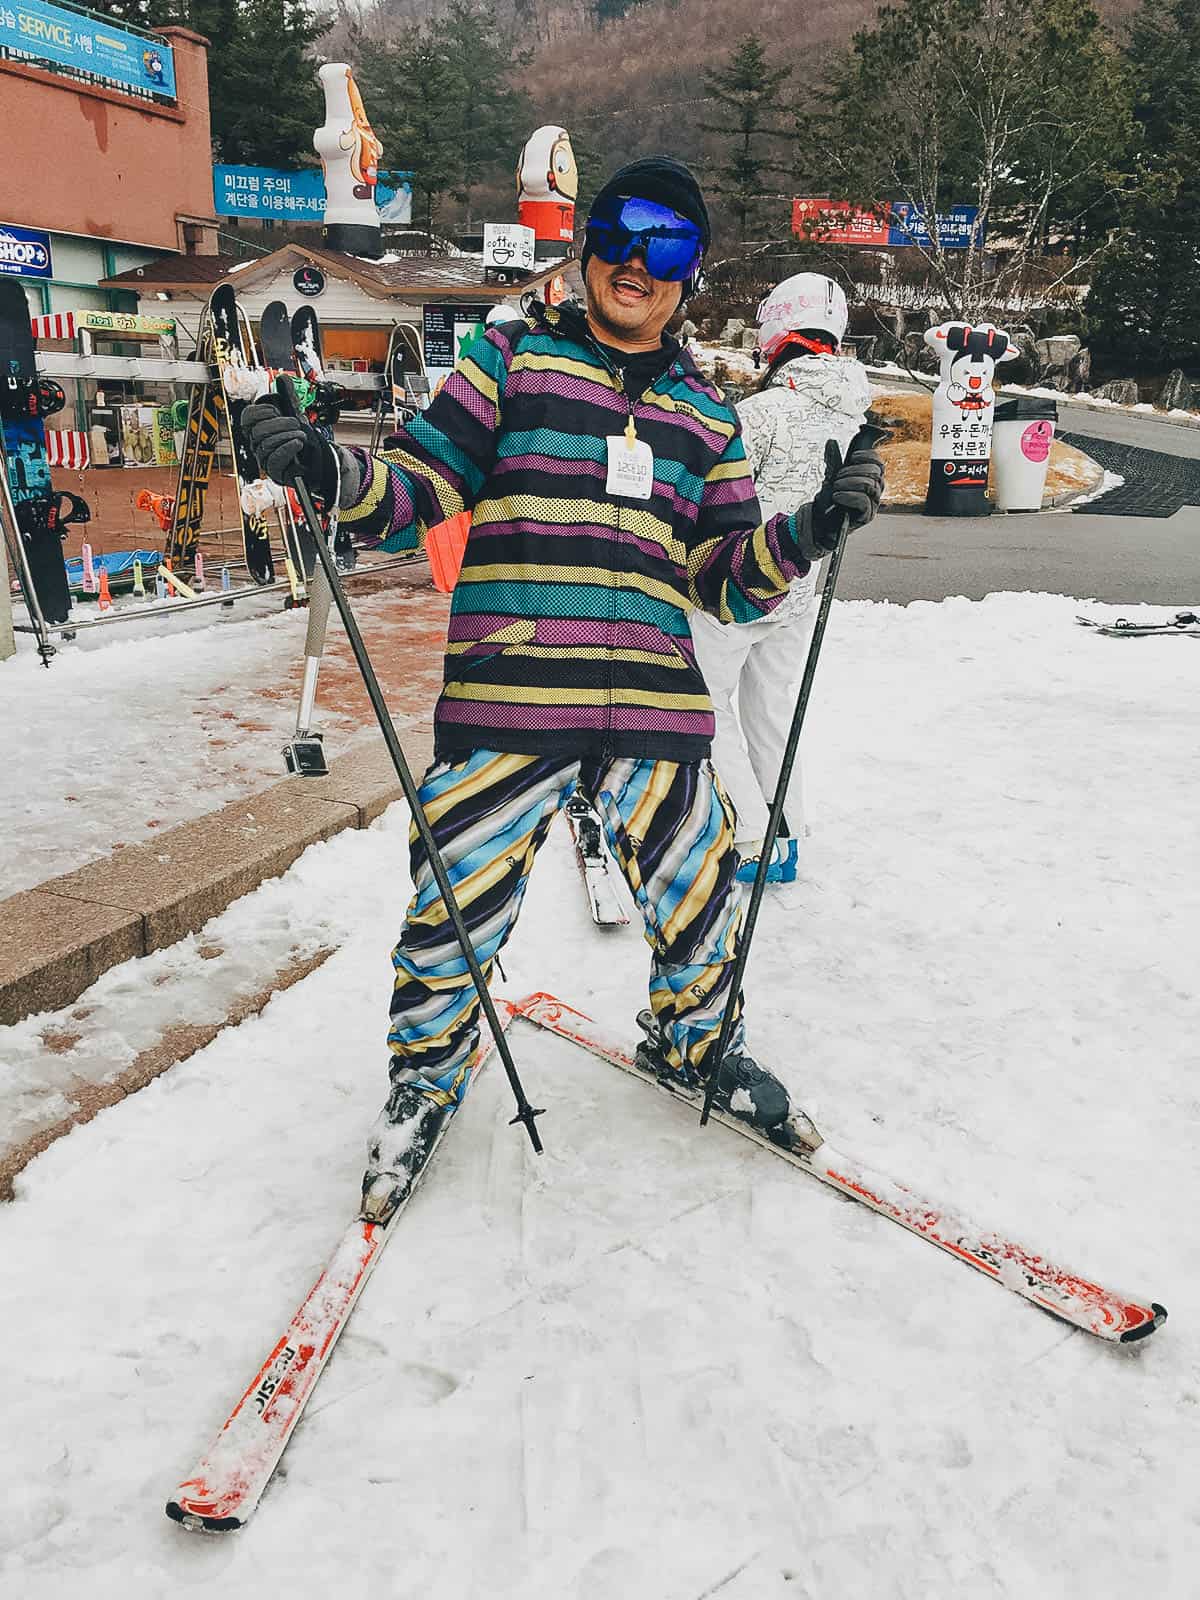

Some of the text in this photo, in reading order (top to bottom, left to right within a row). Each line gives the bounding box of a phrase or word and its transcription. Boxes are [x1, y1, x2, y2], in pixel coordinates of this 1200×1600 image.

[18, 14, 72, 48] SERVICE
[224, 174, 291, 193] 미끄럼 주의!
[225, 192, 327, 211] 계단을 이용해주세요
[487, 236, 518, 248] coffee
[952, 441, 987, 457] 전문점
